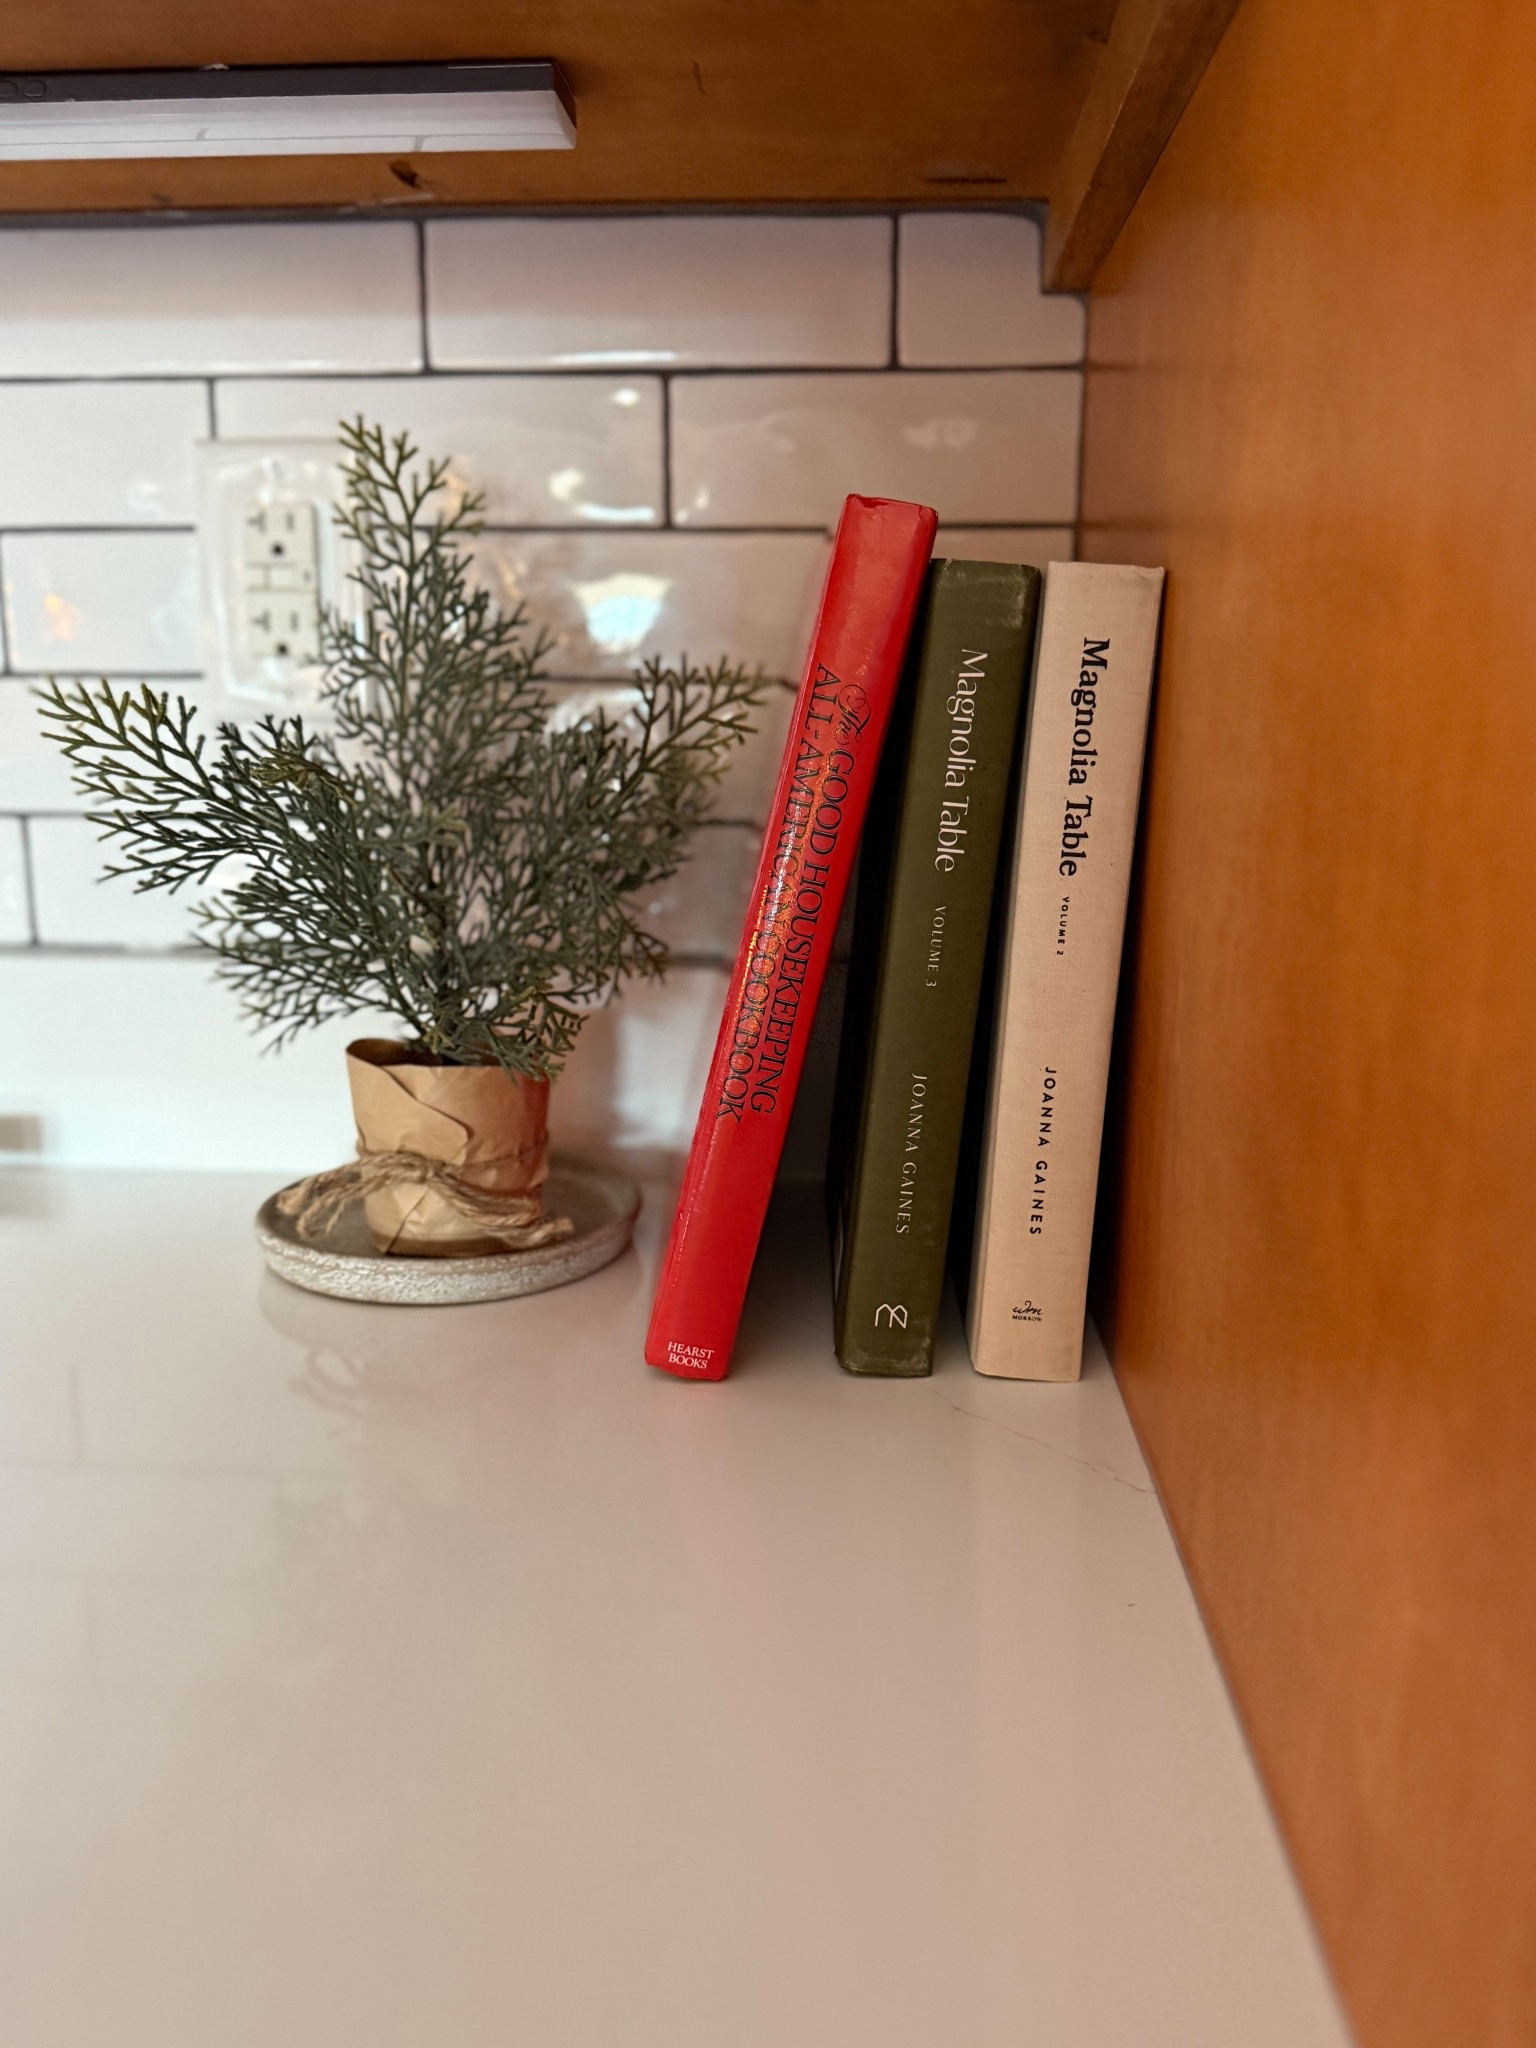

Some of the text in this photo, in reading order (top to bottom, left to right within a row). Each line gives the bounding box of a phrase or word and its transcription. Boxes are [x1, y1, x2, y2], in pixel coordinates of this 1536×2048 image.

[934, 648, 989, 873] Magnolia Table
[1058, 637, 1111, 877] Magnolia Table
[715, 662, 842, 1124] ALL-AMERICAN COOKBOOK
[750, 684, 871, 1114] The GOOD HOUSEKEEPING
[925, 906, 947, 987] VOLUME 3
[1058, 896, 1070, 945] VOLUME
[895, 1073, 928, 1234] JOANNA GAINES
[1029, 1066, 1057, 1236] JOANNA GAINES
[667, 1341, 715, 1360] HEARST
[668, 1352, 709, 1370] BOOKS
[1012, 1314, 1042, 1322] MORROW
